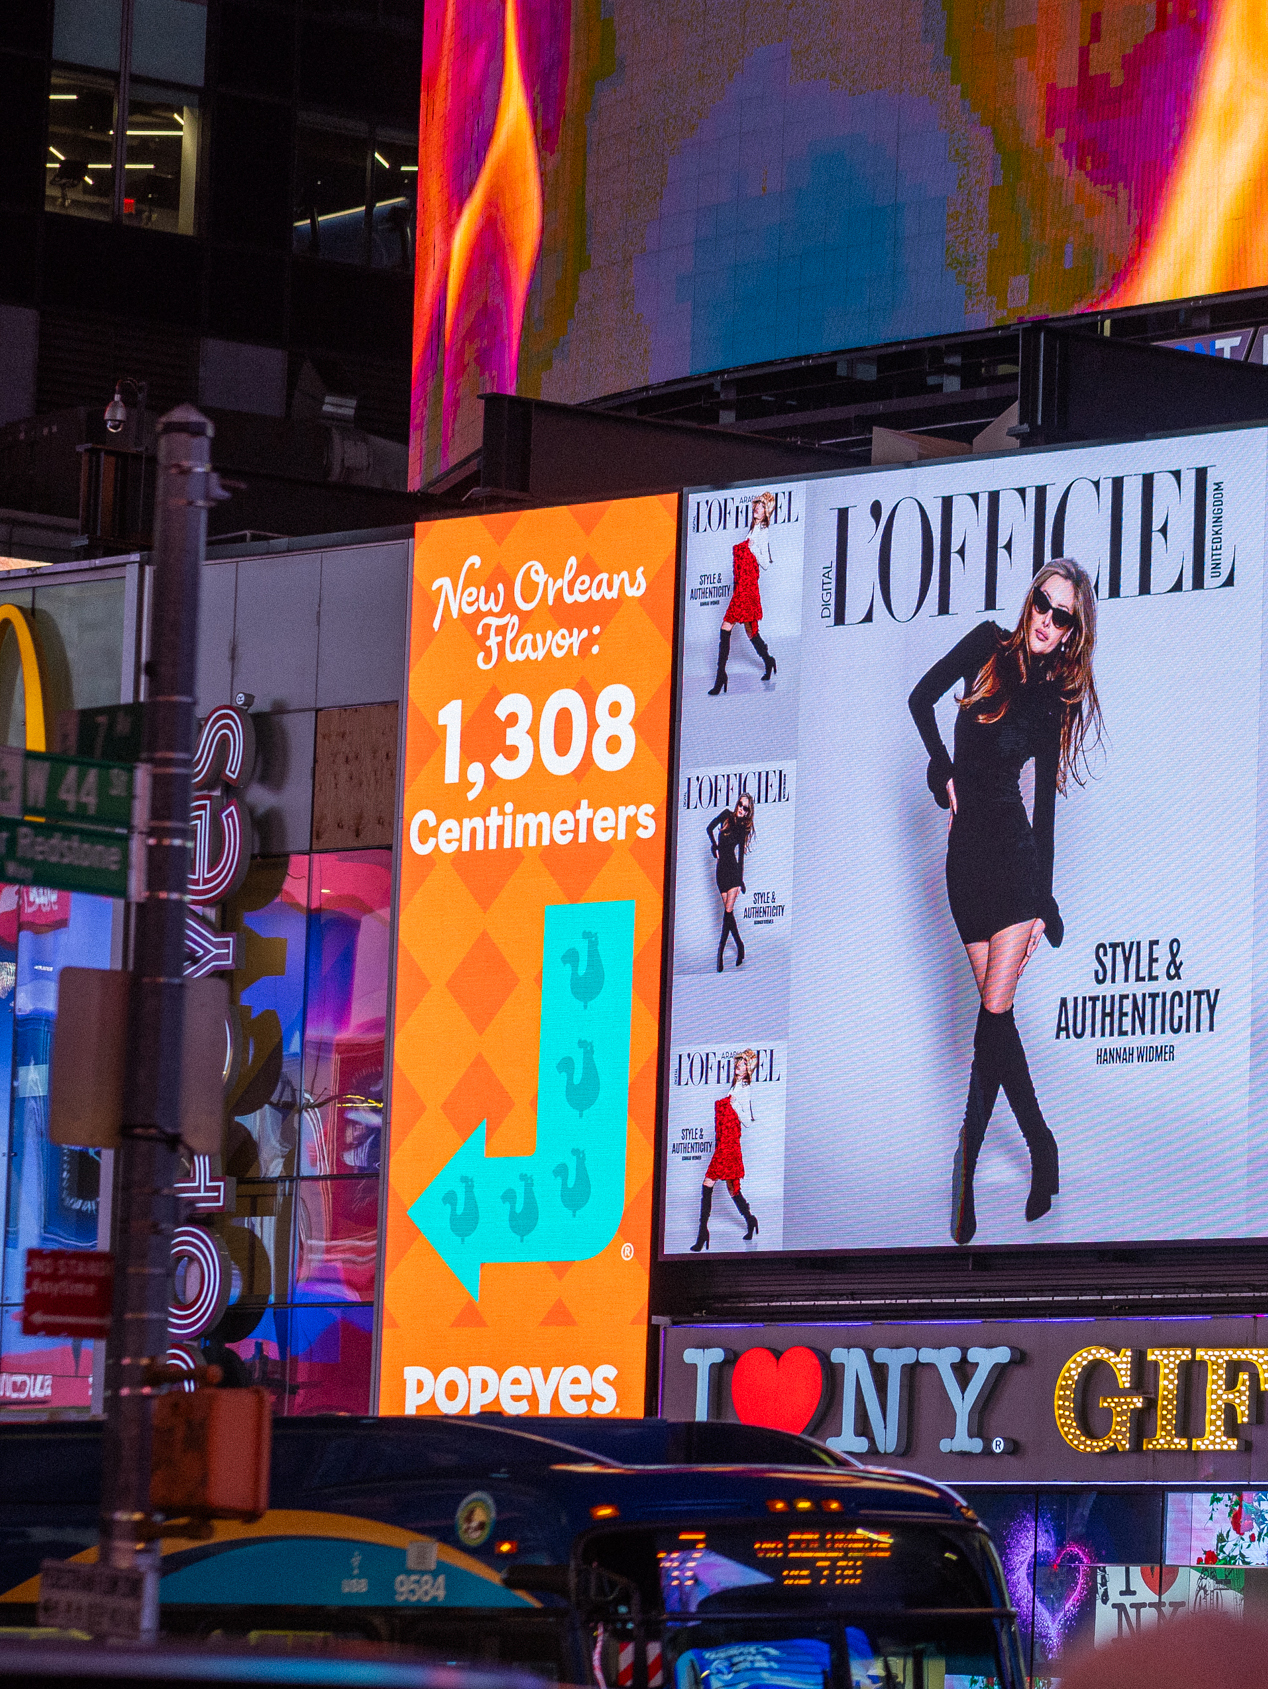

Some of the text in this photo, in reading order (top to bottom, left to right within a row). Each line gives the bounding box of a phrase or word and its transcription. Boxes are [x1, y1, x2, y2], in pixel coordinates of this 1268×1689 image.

[1210, 480, 1224, 579] UNITEDKINGDOM
[431, 555, 646, 631] New Orleans
[700, 573, 717, 586] STYLE
[820, 560, 834, 619] DIGITAL
[477, 612, 600, 670] Flavor:
[437, 683, 637, 802] 1,308
[57, 764, 99, 816] 44
[16, 825, 122, 872] Redstone
[409, 799, 656, 856] Centimeters
[743, 904, 785, 919] AUTHENTICITY
[753, 891, 776, 905] STYLE &
[1094, 937, 1183, 985] STYLE &
[1055, 989, 1220, 1040] AUTHENTICITY
[1096, 1045, 1175, 1064] HANNAH WIDMER
[671, 1141, 713, 1154] AUTHENTICITY
[682, 1129, 698, 1141] STYLE
[394, 1573, 446, 1602] 9584
